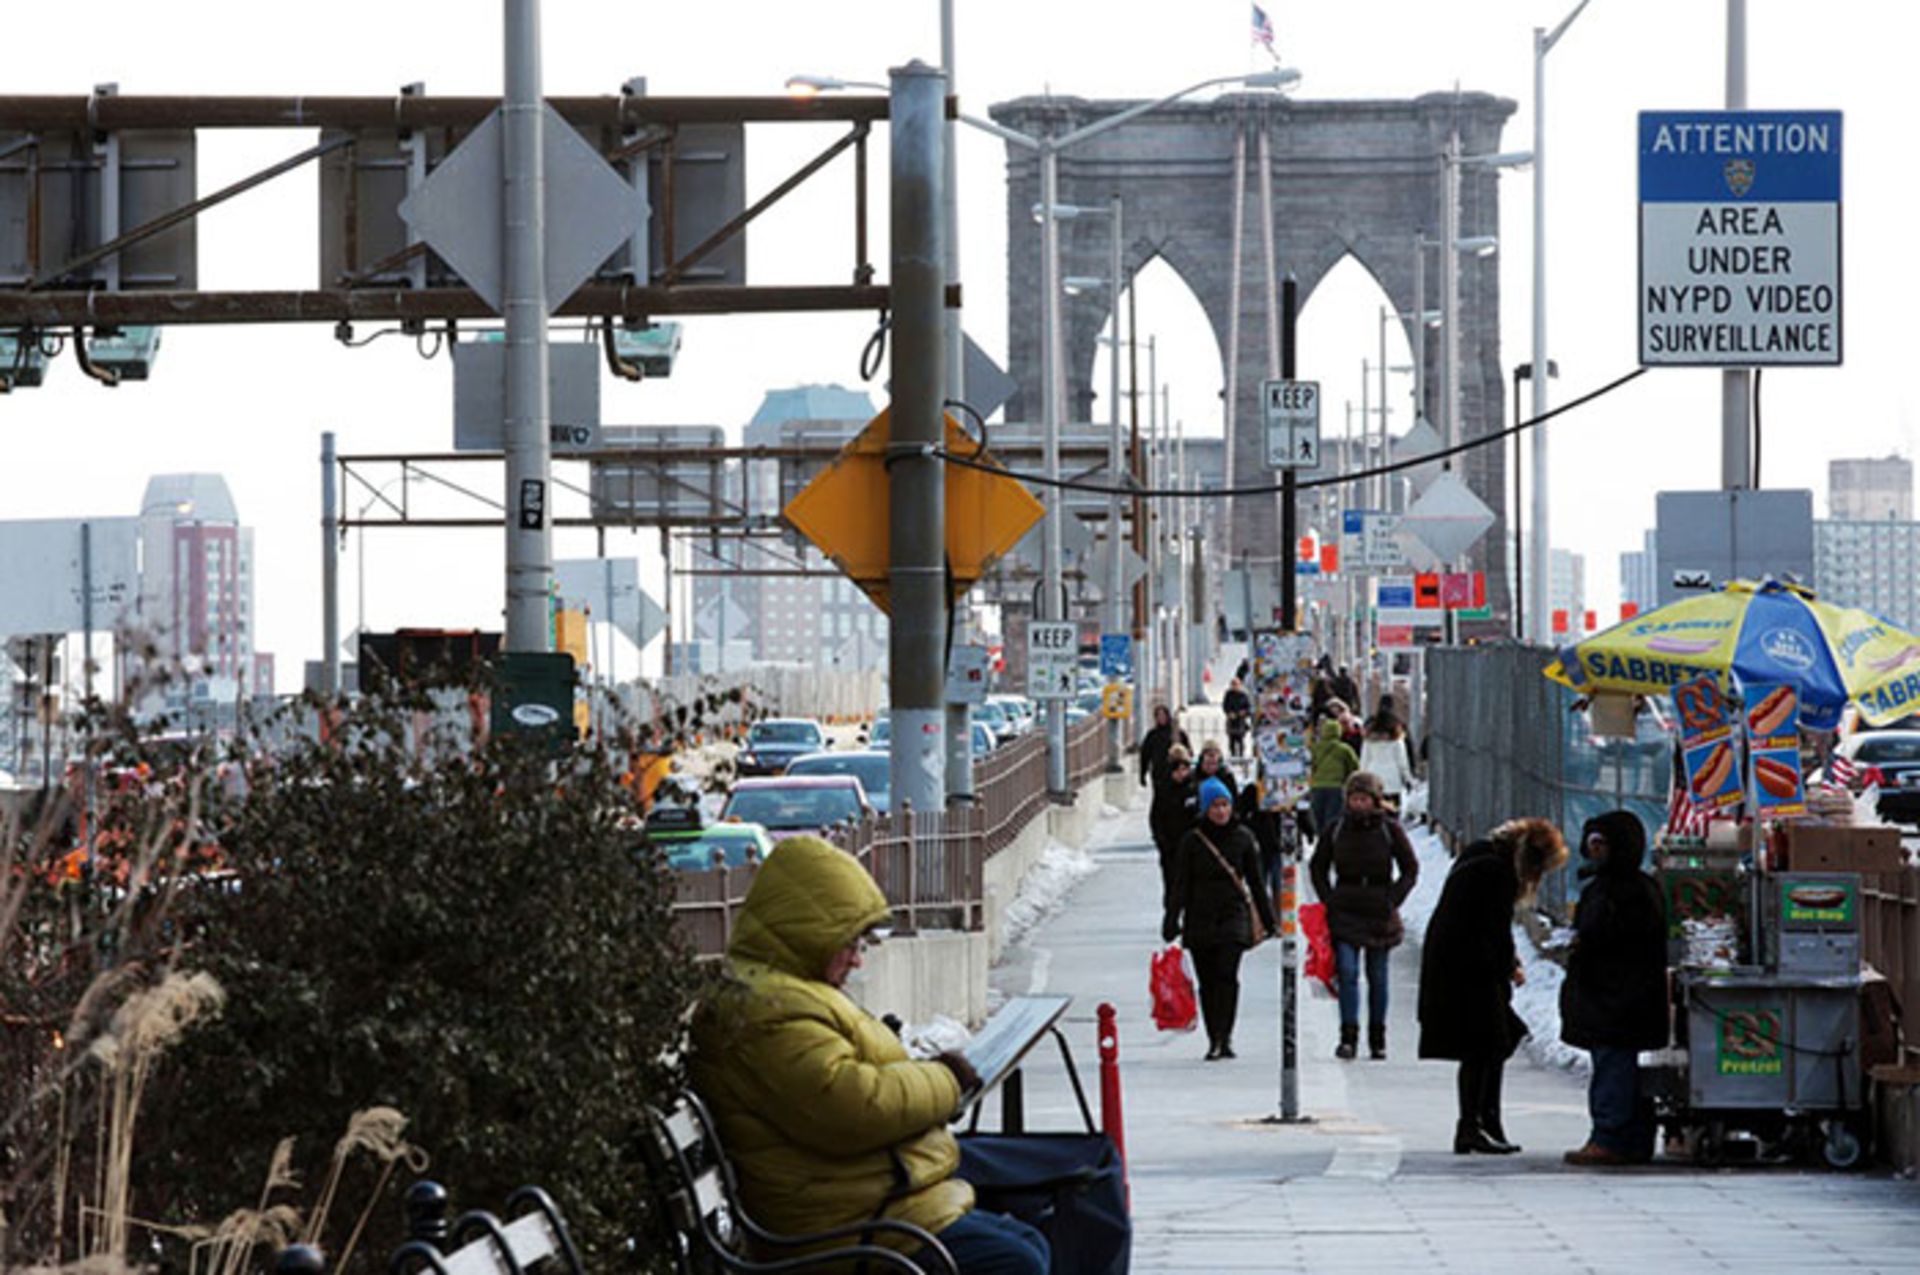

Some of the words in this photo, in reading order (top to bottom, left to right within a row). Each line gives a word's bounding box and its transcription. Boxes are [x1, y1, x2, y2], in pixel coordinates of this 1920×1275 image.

[1653, 124, 1828, 153] ATTENTION
[1697, 208, 1783, 234] AREA
[1688, 247, 1791, 274] UNDER
[1648, 285, 1731, 313] NYPD
[1747, 285, 1832, 313] VIDEO
[1650, 325, 1830, 351] SURVEILLANCE
[1271, 387, 1314, 409] KEEP
[1032, 628, 1073, 648] KEEP
[1722, 1060, 1781, 1073] Pretzel
